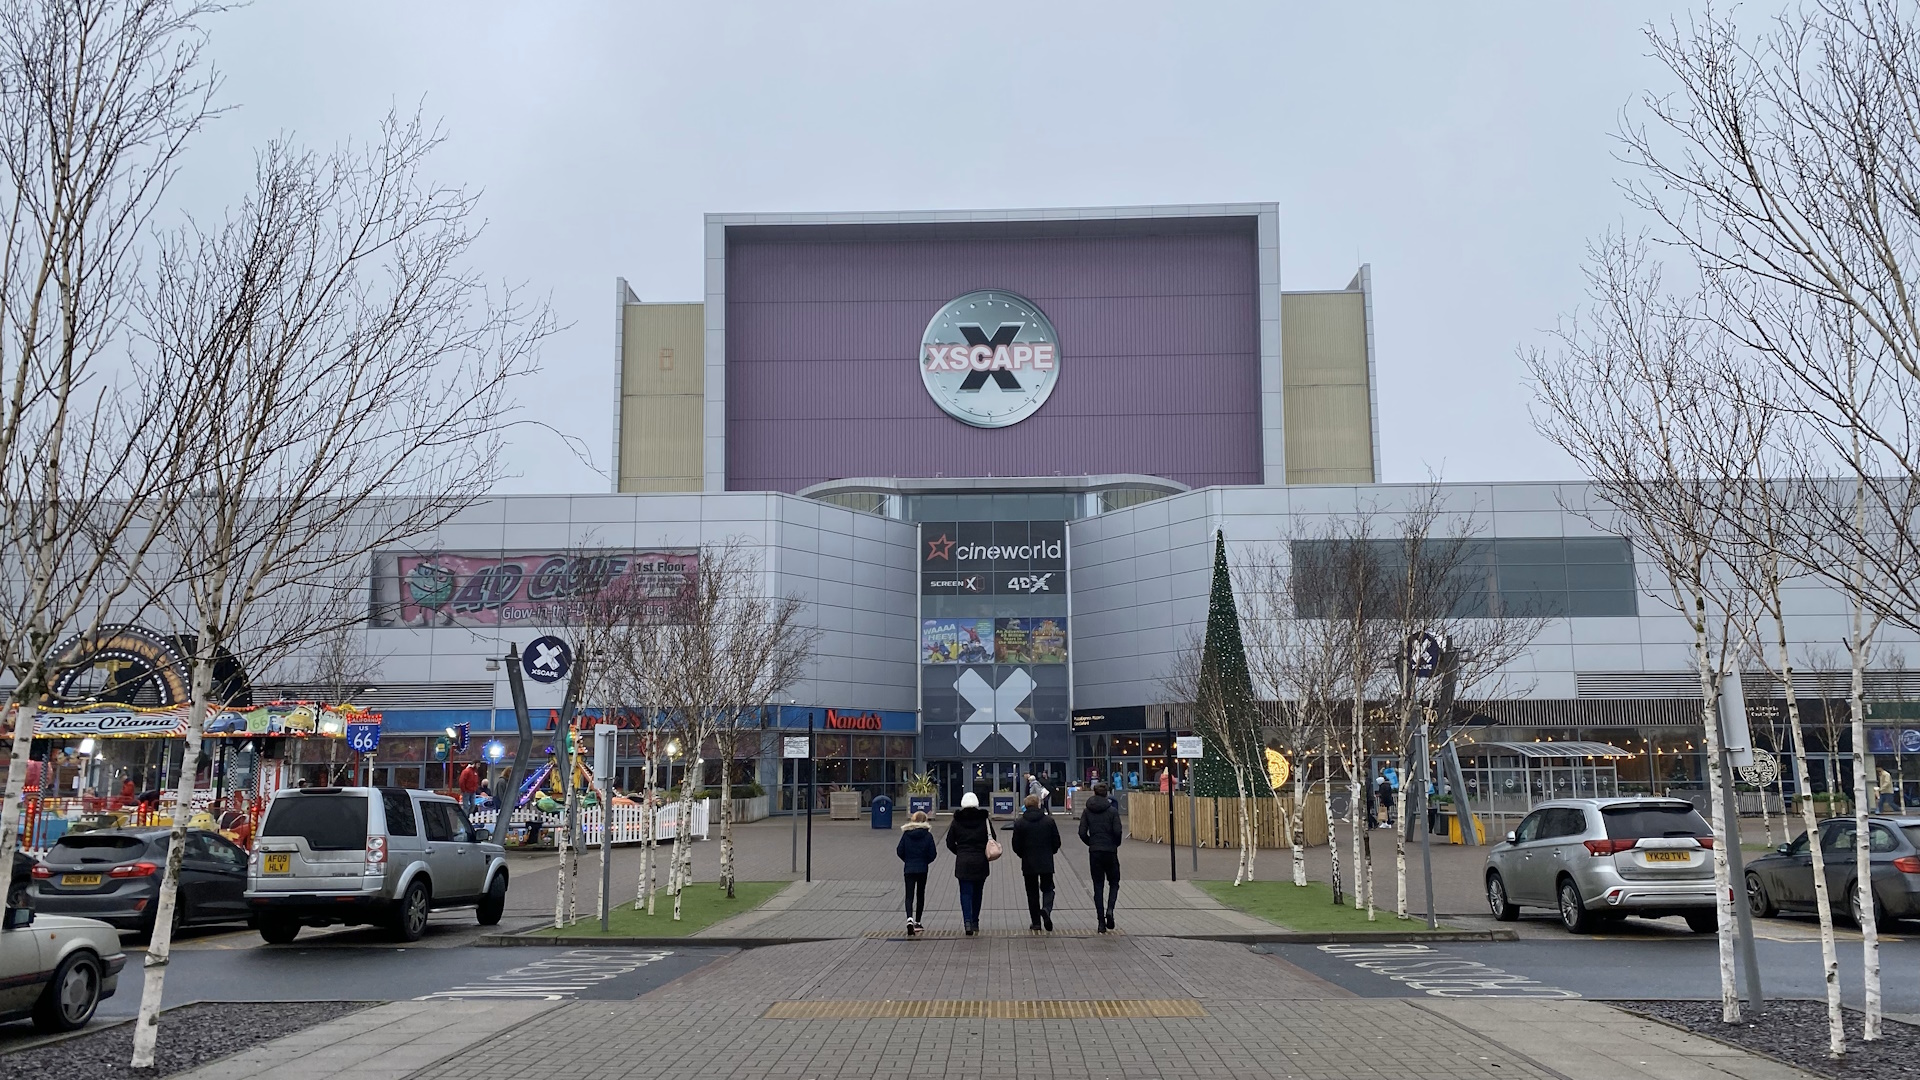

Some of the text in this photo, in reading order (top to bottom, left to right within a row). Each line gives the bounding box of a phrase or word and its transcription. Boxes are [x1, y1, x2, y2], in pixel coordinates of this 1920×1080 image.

[927, 345, 1054, 371] XSCAPE
[956, 540, 1062, 560] cineworld
[636, 562, 687, 572] 1st Floor
[451, 563, 524, 613] 4D
[1007, 573, 1053, 593] 4DX
[923, 623, 956, 635] WAAAA
[928, 633, 957, 641] HEEY!
[531, 668, 559, 678] XSCAPE
[252, 716, 268, 729] 66
[825, 708, 882, 731] Nando's
[353, 732, 373, 749] 66
[267, 854, 287, 863] AF09
[1648, 852, 1687, 860] YK20 TVL
[269, 863, 284, 871] HLV
[1316, 944, 1583, 998] CROSSING
